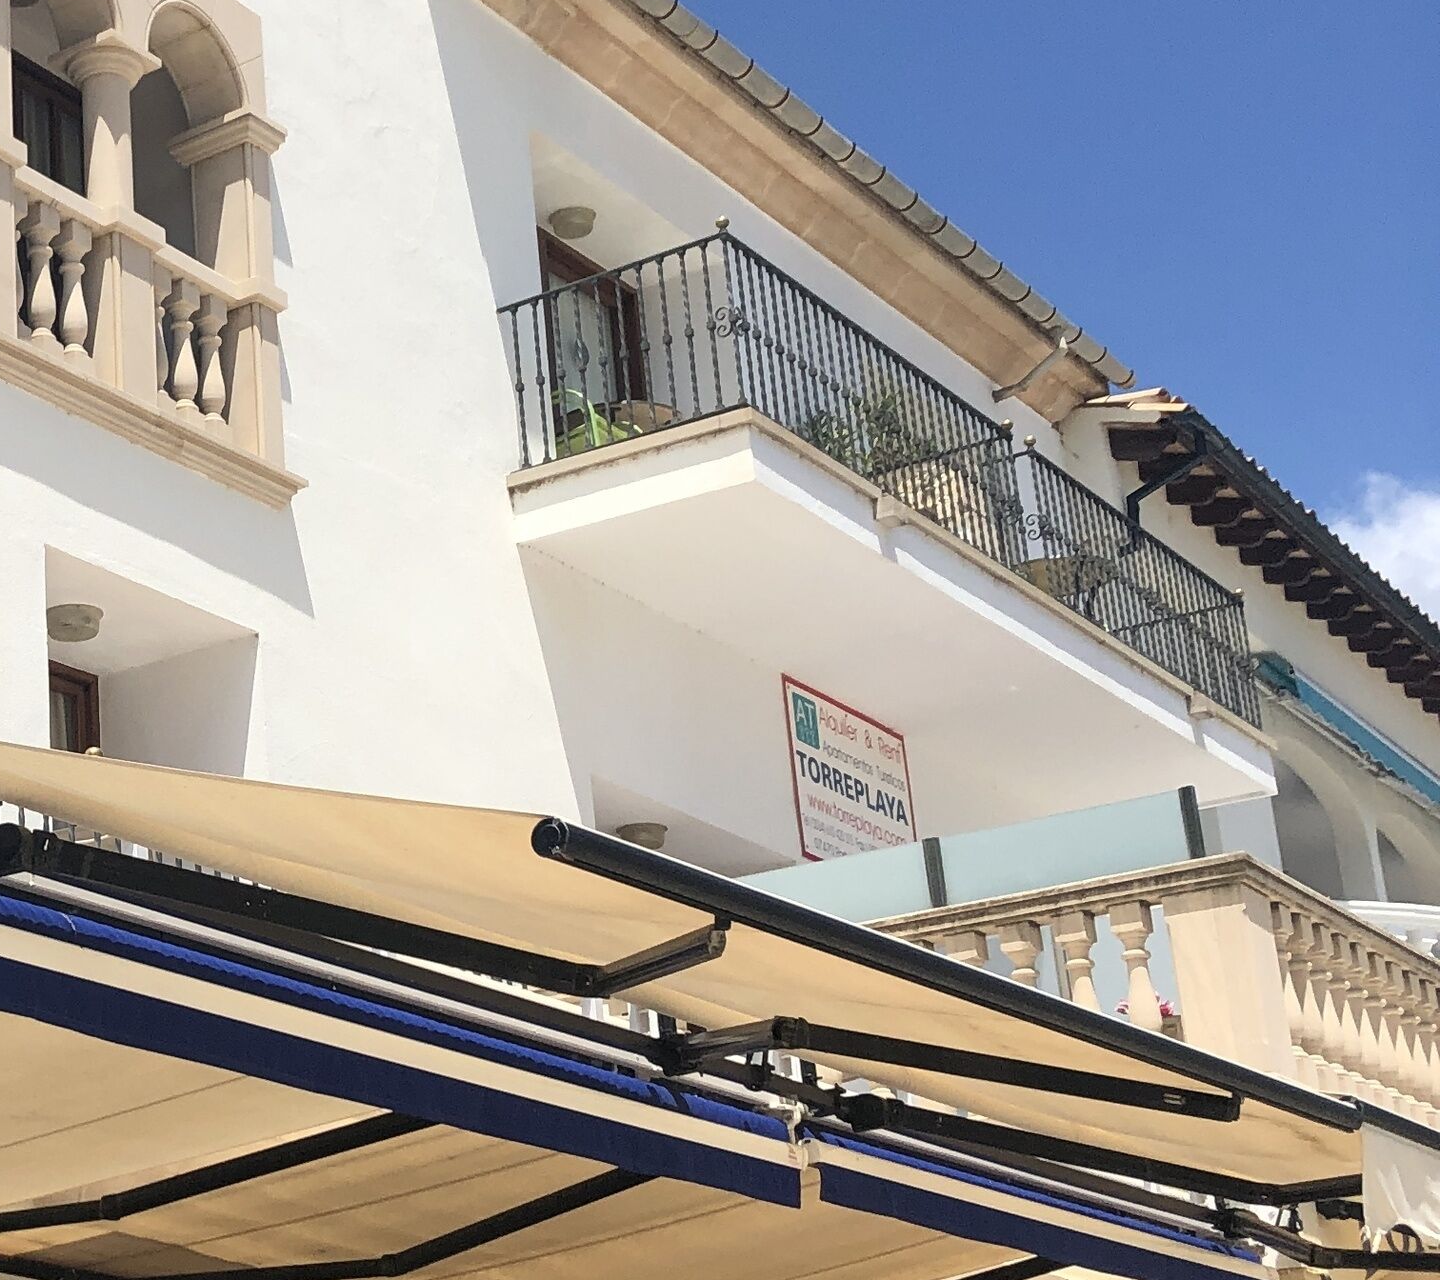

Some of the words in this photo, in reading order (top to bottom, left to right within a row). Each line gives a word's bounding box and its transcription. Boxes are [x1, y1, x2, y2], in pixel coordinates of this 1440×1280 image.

[796, 698, 814, 729] AT
[864, 729, 873, 750] &
[796, 749, 910, 827] TORREPLAYA
